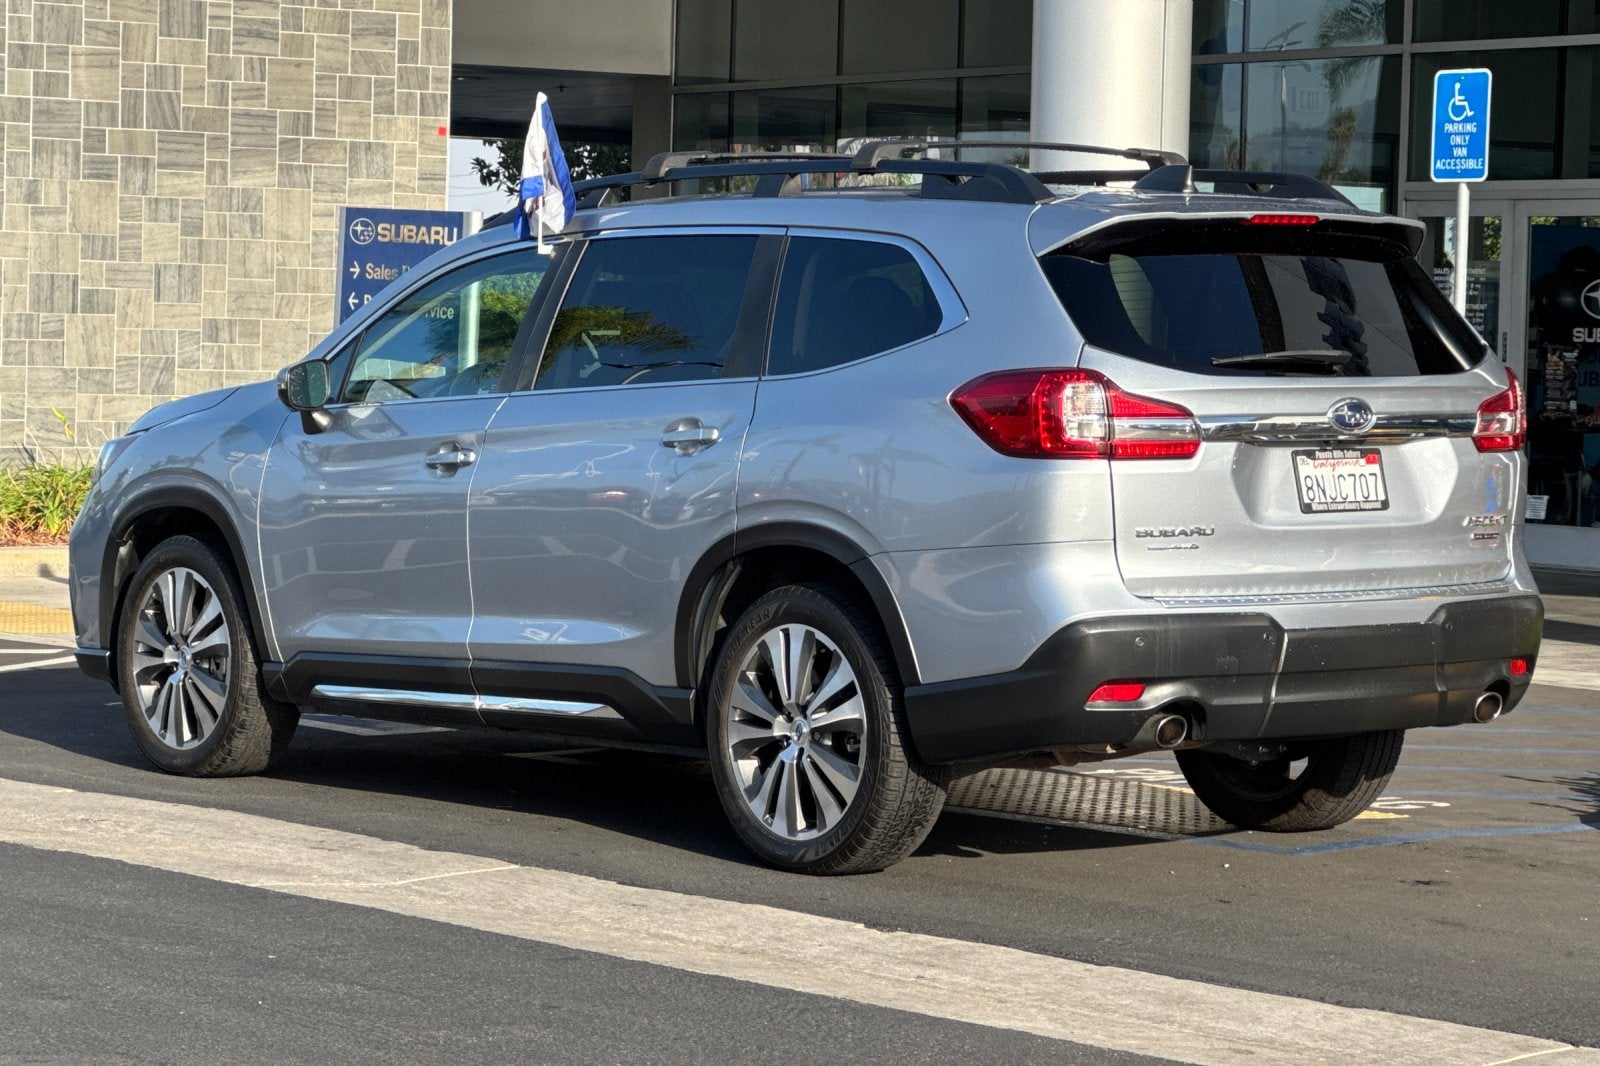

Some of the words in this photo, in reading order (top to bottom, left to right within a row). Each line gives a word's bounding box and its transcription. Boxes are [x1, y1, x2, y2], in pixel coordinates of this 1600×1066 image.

[1444, 122, 1477, 134] PARKING
[1450, 134, 1471, 146] ONLY
[1453, 146, 1468, 158] VAN
[1435, 158, 1484, 170] ACCESSIBLE
[377, 222, 458, 246] SUBARU
[365, 262, 399, 280] Sales
[1304, 472, 1379, 502] 8NJC707
[1134, 526, 1215, 539] SUBARU
